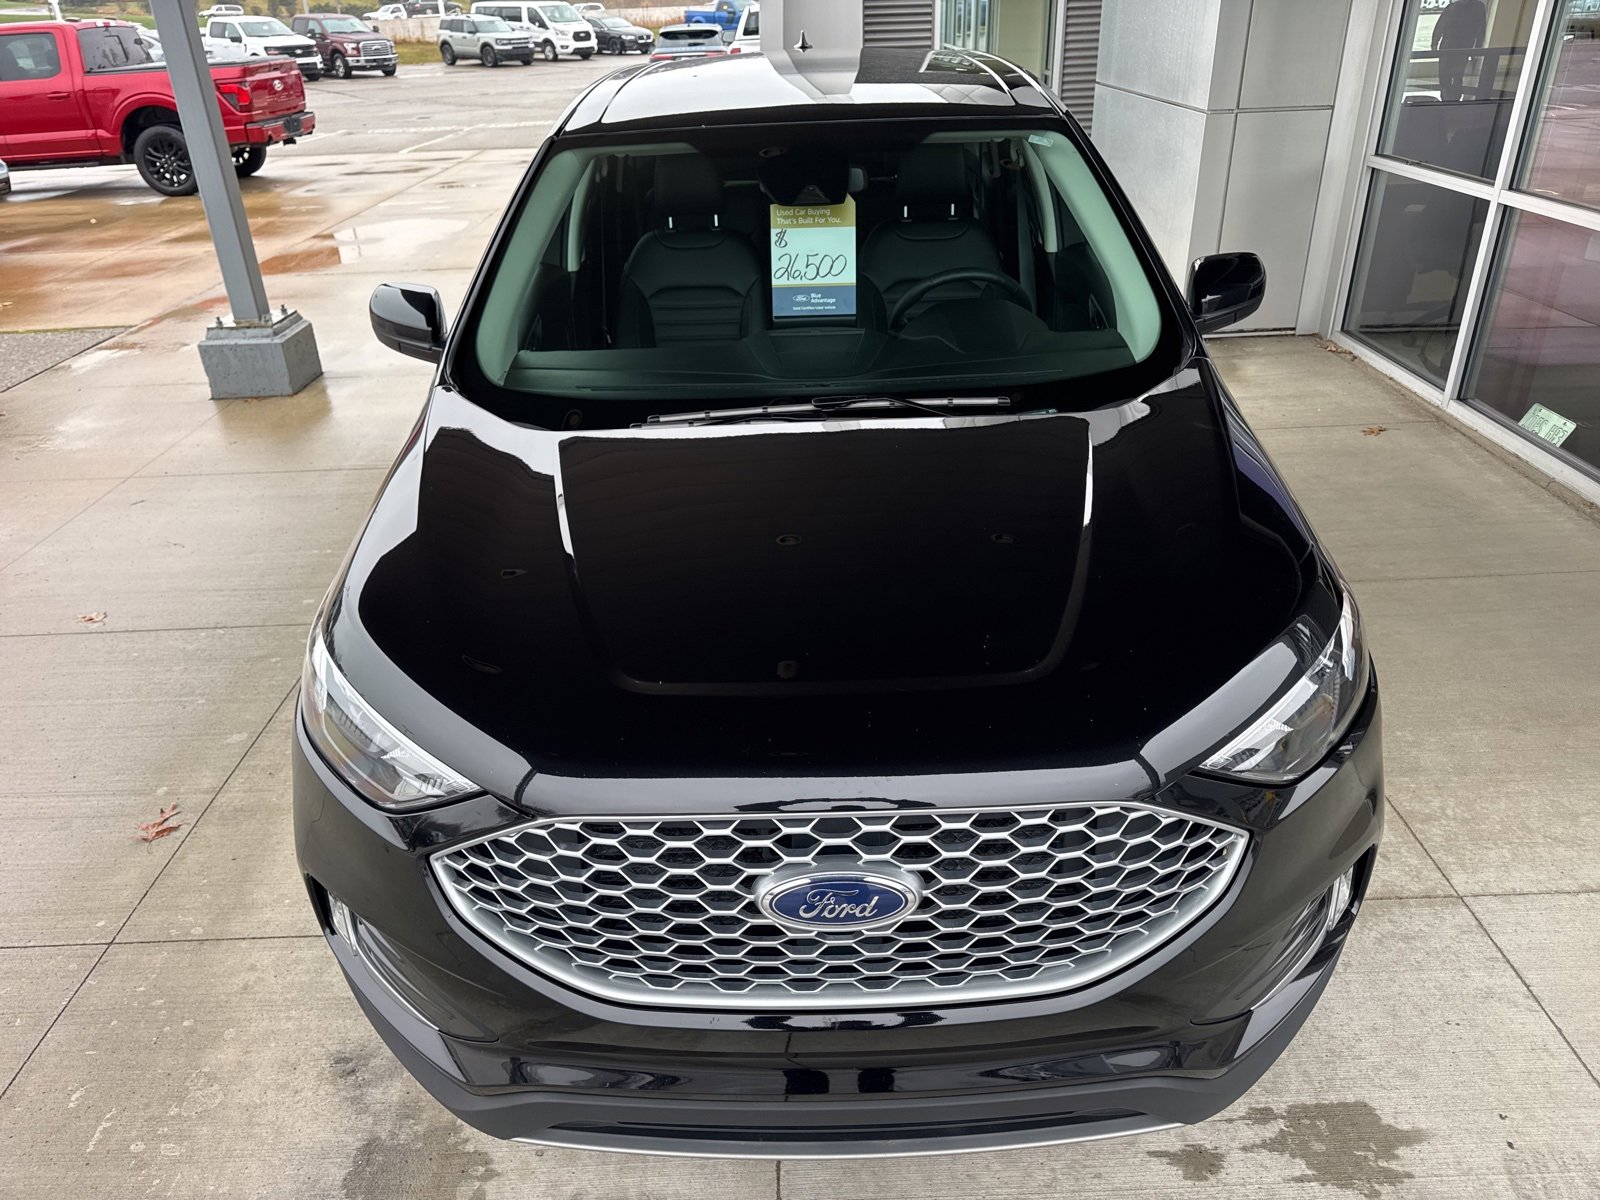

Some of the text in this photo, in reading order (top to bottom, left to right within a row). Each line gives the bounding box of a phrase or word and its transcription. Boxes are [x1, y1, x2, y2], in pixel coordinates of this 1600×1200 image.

[776, 208, 831, 216] Used Car Buying
[777, 217, 797, 225] That's
[774, 228, 788, 248] $
[774, 253, 848, 281] 26,500
[798, 888, 880, 919] Ford
